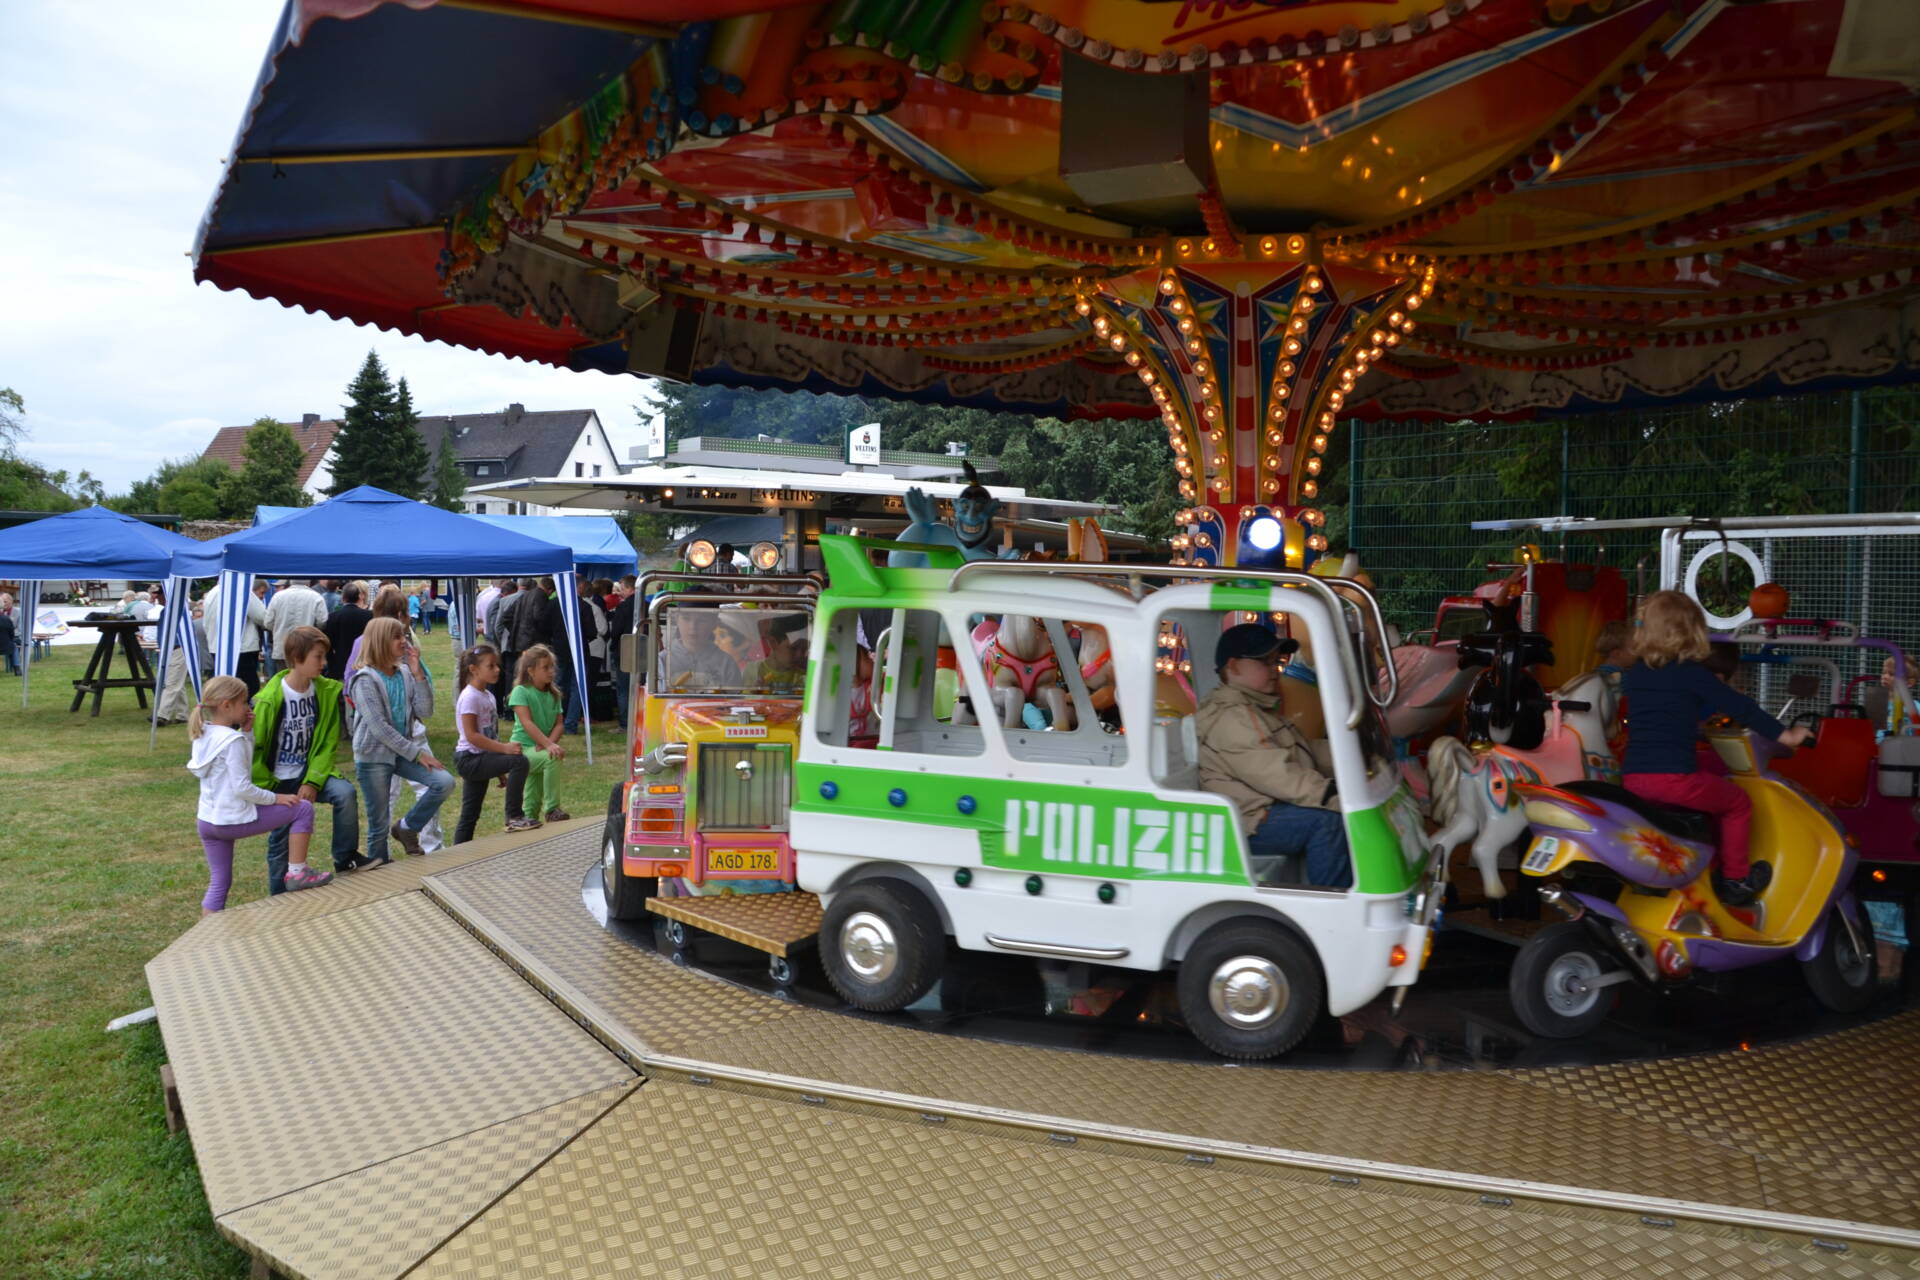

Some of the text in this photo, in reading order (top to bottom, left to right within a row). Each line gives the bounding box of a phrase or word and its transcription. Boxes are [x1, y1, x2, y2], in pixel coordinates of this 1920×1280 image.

[769, 488, 816, 502] VELTINS
[283, 719, 304, 731] CARE
[1003, 798, 1226, 876] POLIZEI
[715, 854, 772, 869] AGD 178
